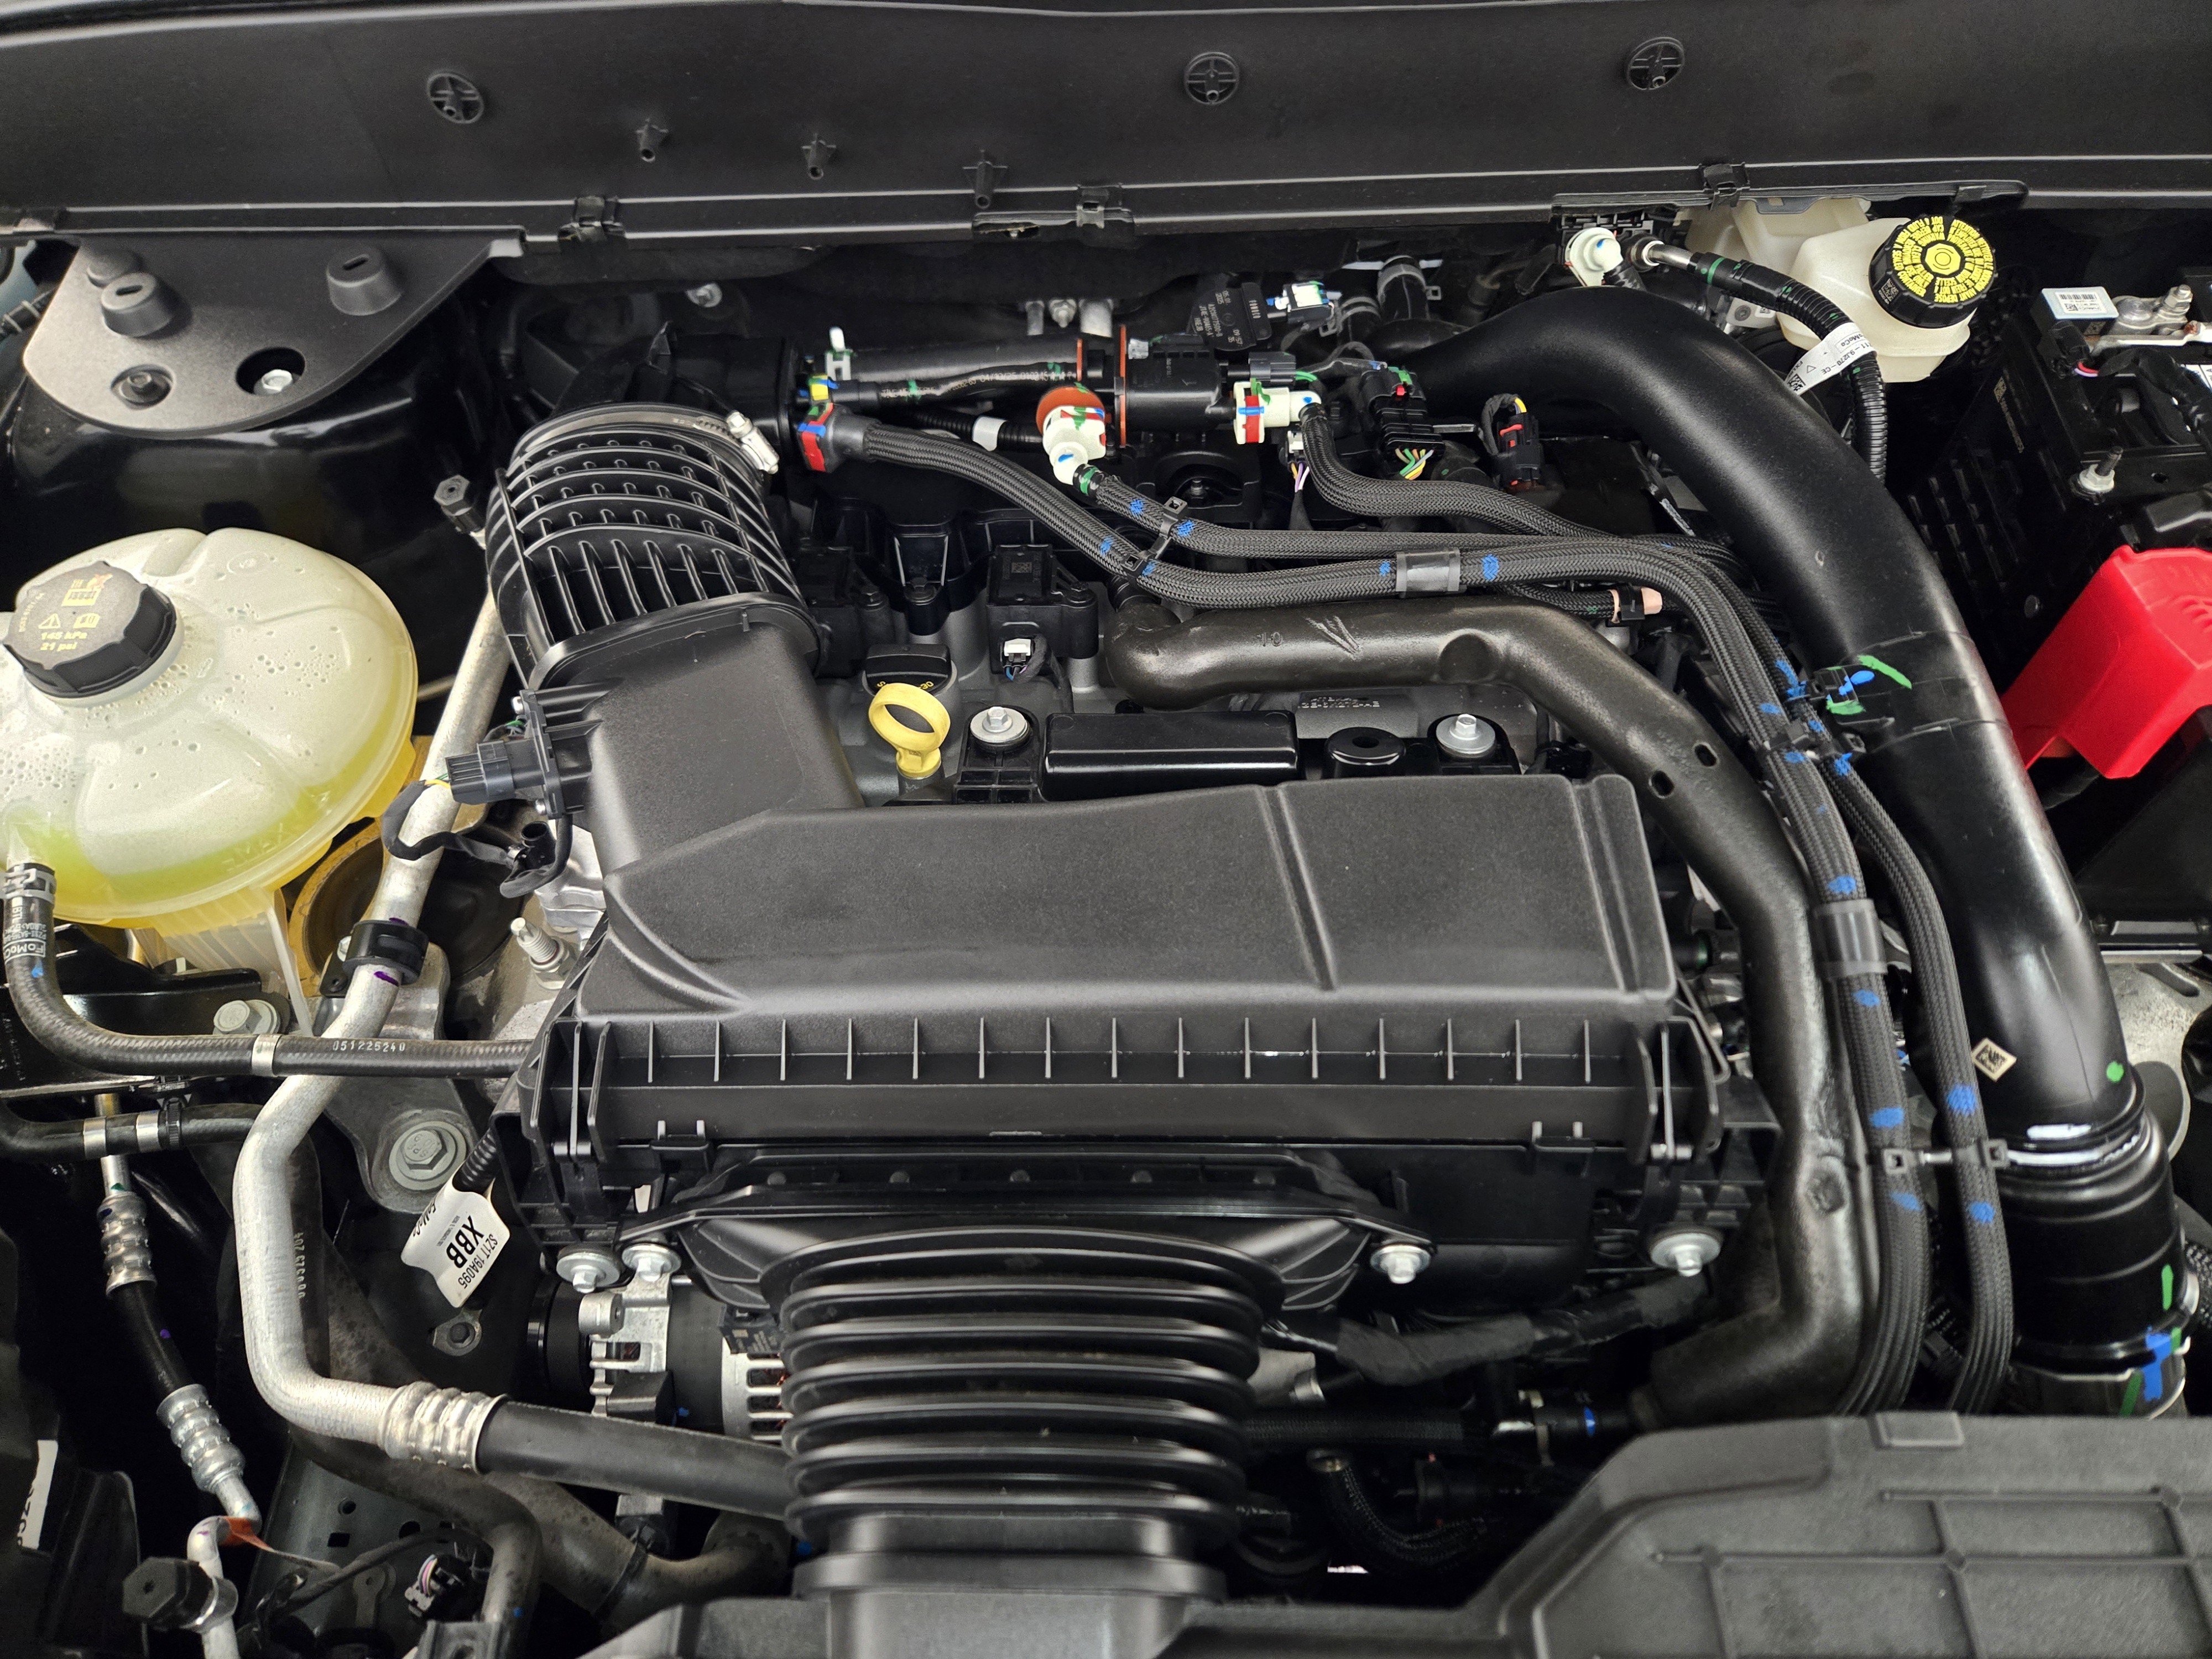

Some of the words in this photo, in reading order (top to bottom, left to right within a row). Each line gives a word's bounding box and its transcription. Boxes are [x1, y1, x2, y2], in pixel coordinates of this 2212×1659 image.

[1907, 218, 1925, 234] FLUID
[1931, 216, 1943, 225] DOT
[1932, 223, 1944, 233] CAP
[1895, 228, 1911, 244] FROM
[1909, 223, 1932, 242] BEFORE
[1917, 230, 1945, 246] WARNING
[1950, 219, 1980, 241] ATTENTION
[1900, 238, 1916, 266] REMOVING
[1910, 243, 1922, 265] CLEAN
[1975, 237, 1993, 262] NETTOYER
[1892, 249, 1904, 270] SEALED
[1982, 261, 1994, 270] LE
[1904, 264, 1918, 279] USE
[1912, 263, 1934, 283] FILLER
[1897, 269, 1926, 297] CONTAINER
[1911, 273, 1931, 289] ONLY
[1950, 281, 1968, 295] FREIN
[1939, 285, 1950, 295] DOT
[1958, 286, 1976, 301] AVANT
[332, 1040, 406, 1052] 051225240
[446, 1215, 484, 1269] XBB
[483, 1234, 498, 1260] SZ1T
[458, 1257, 486, 1289] 19A095
